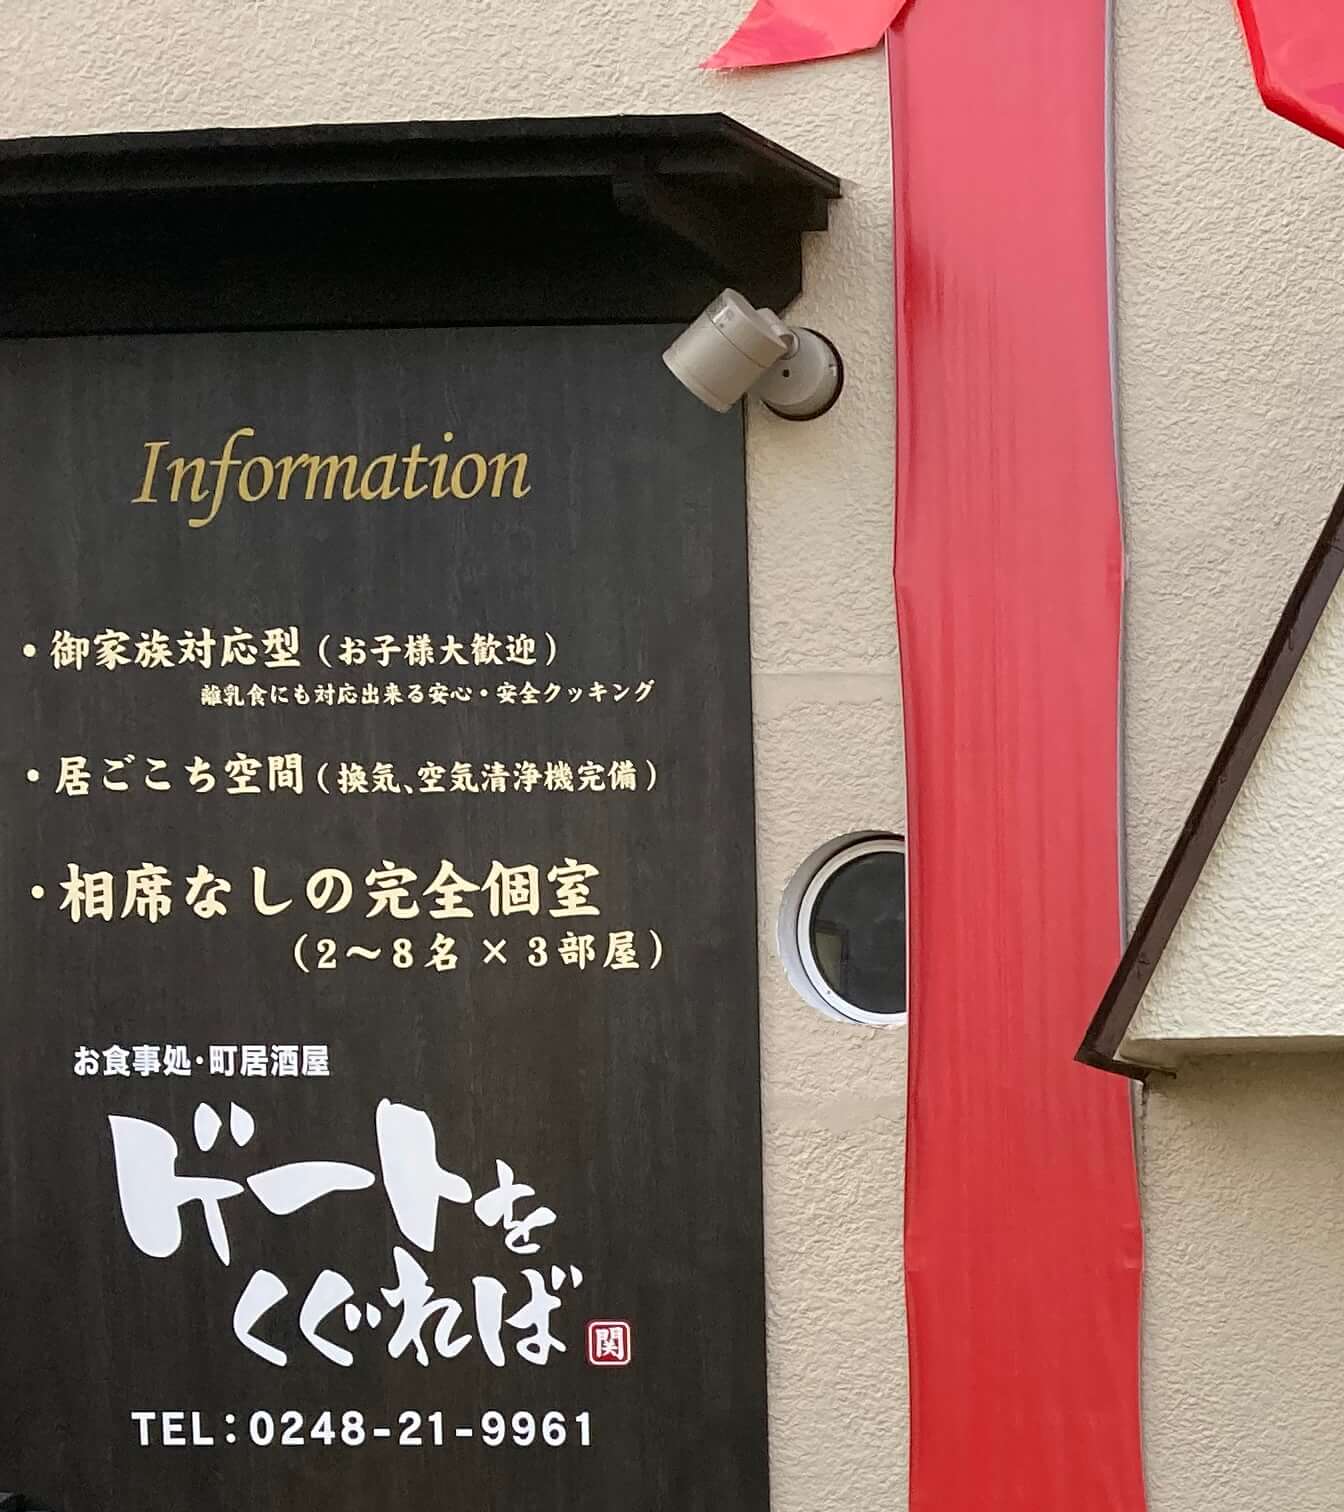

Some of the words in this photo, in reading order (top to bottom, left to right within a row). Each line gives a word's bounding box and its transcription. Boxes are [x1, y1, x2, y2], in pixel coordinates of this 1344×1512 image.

[132, 428, 532, 528] Information
[72, 1044, 330, 1078] お食事処・町居酒屋
[232, 1246, 584, 1367] くぐれば
[592, 1325, 628, 1363] 関
